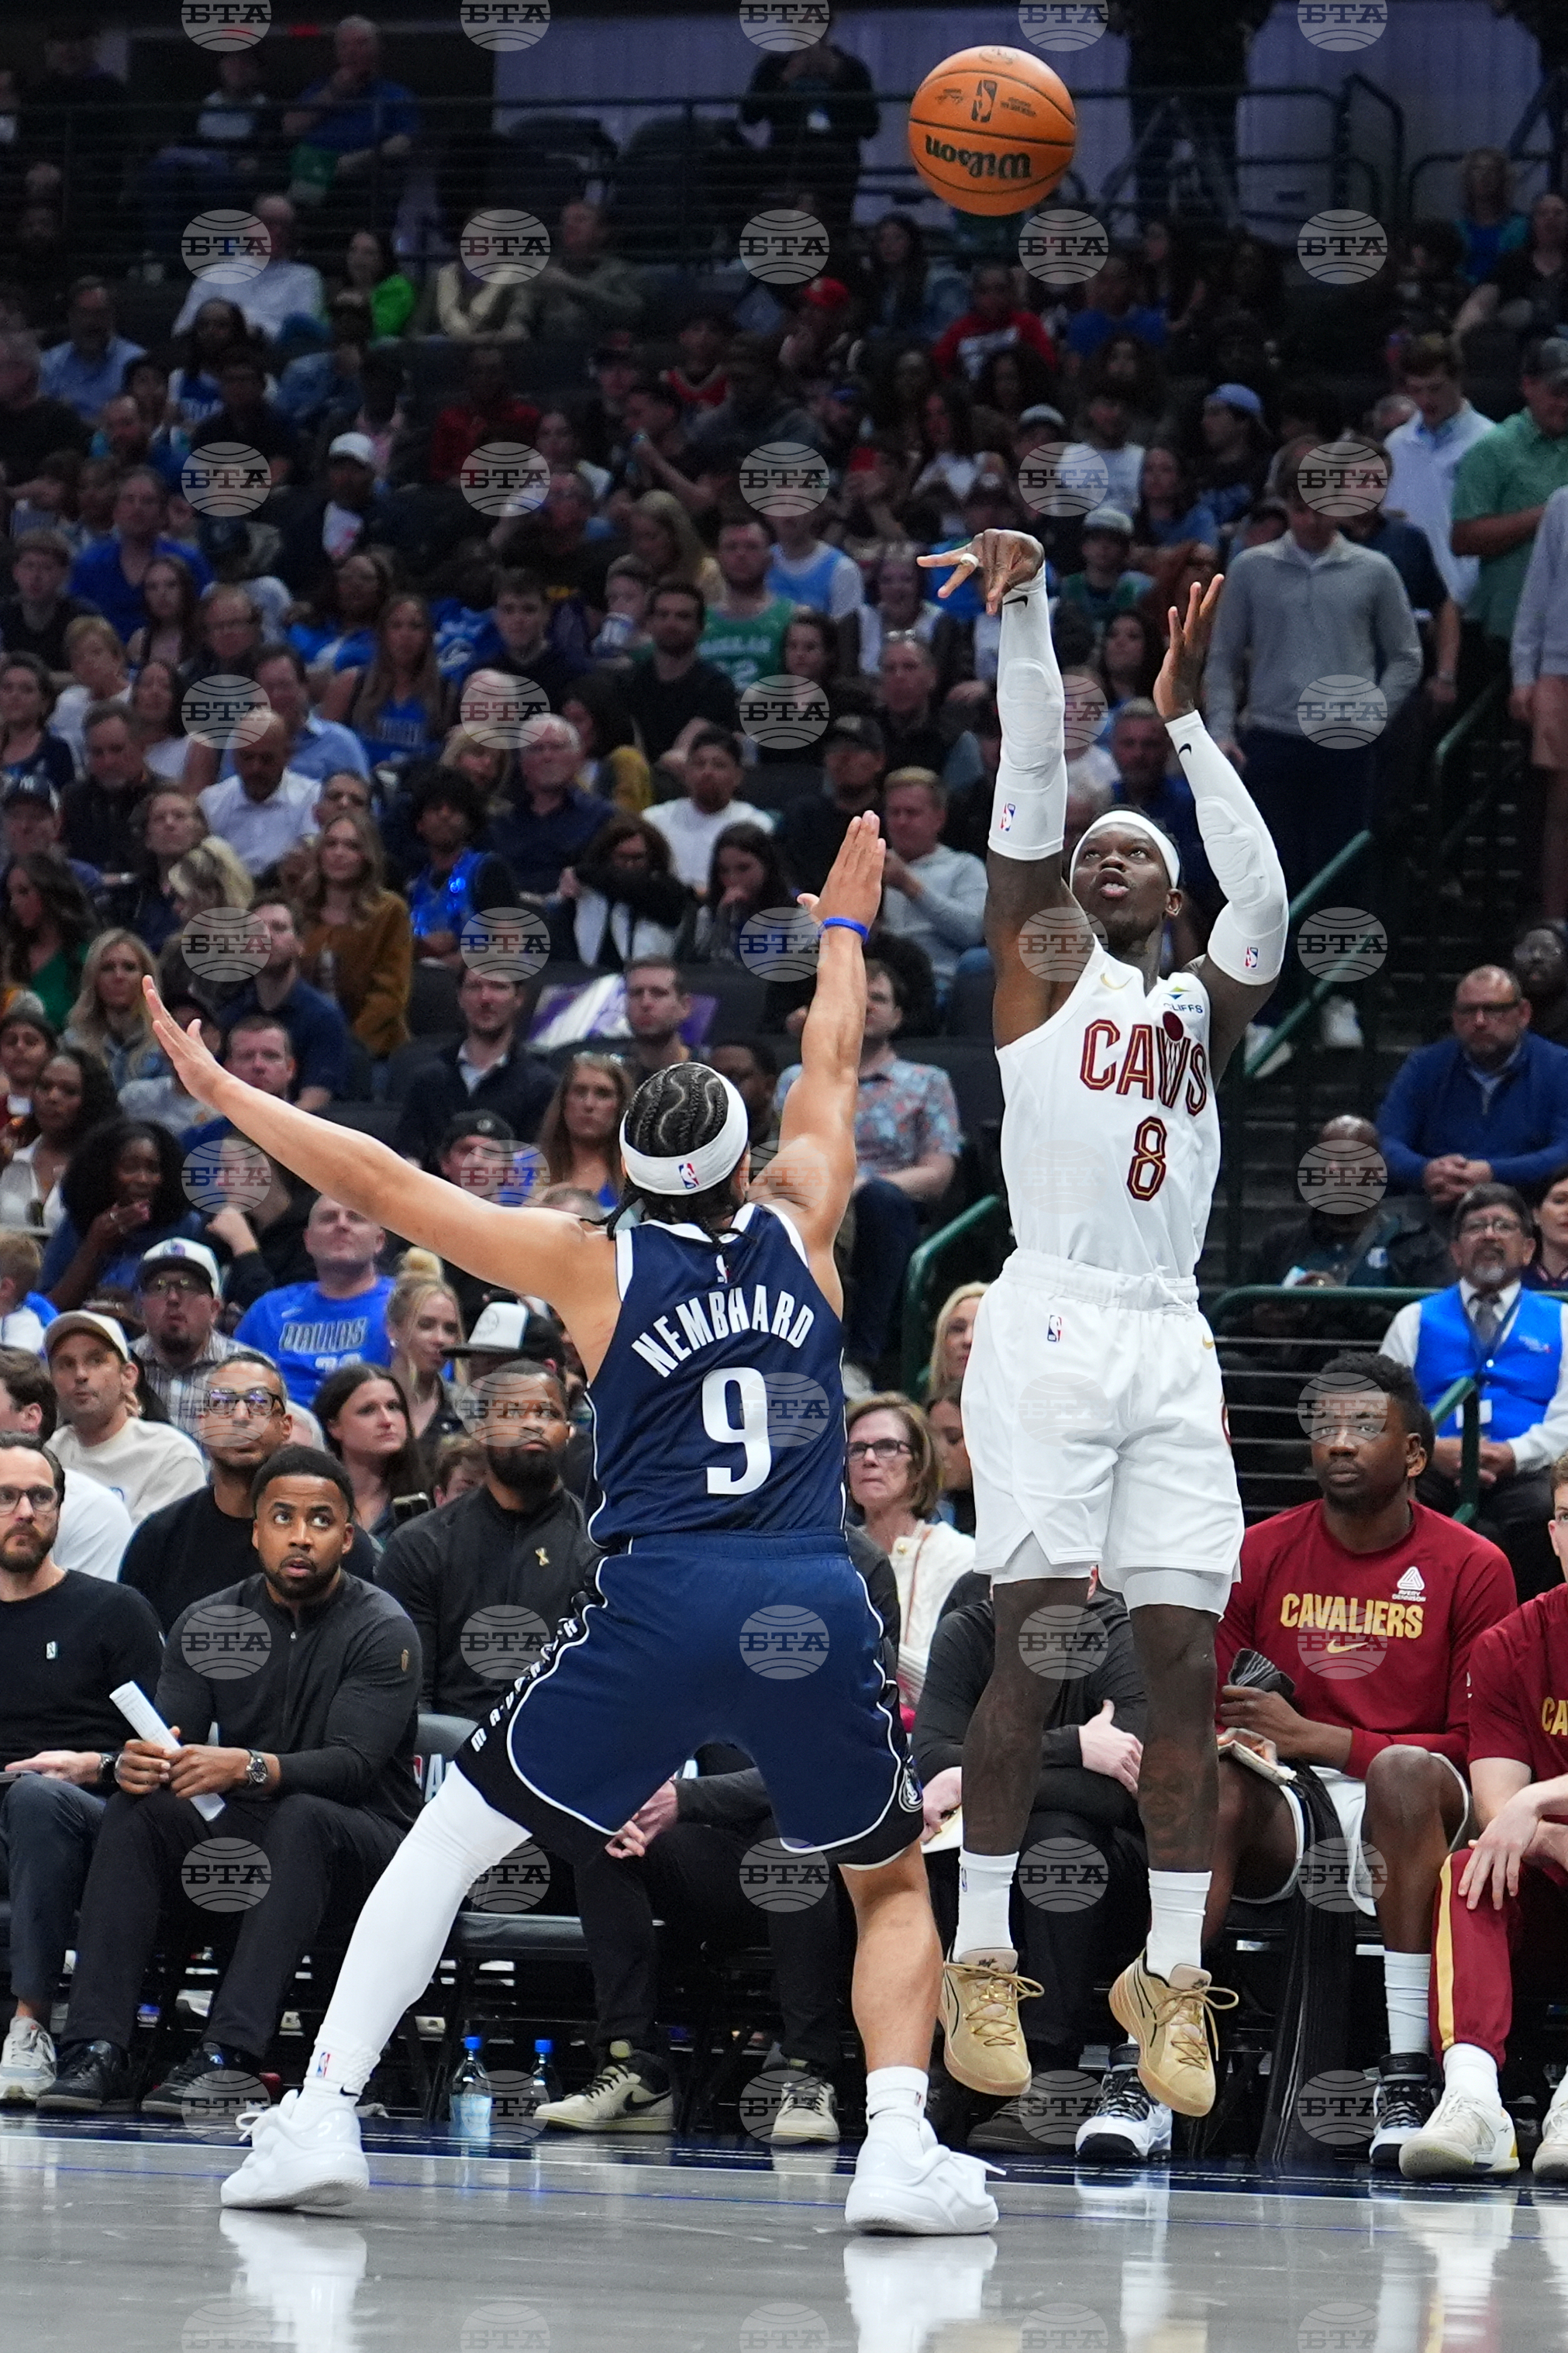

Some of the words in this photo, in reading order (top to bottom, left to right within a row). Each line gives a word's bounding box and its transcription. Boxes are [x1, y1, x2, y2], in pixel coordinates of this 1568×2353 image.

[925, 134, 1031, 178] Wilson
[1080, 1019, 1208, 1116] CAVS
[1126, 1116, 1167, 1201] 8
[631, 1284, 814, 1378] NEMBHARD
[701, 1367, 772, 1495] 9
[1280, 1593, 1424, 1639] CAVALIERS
